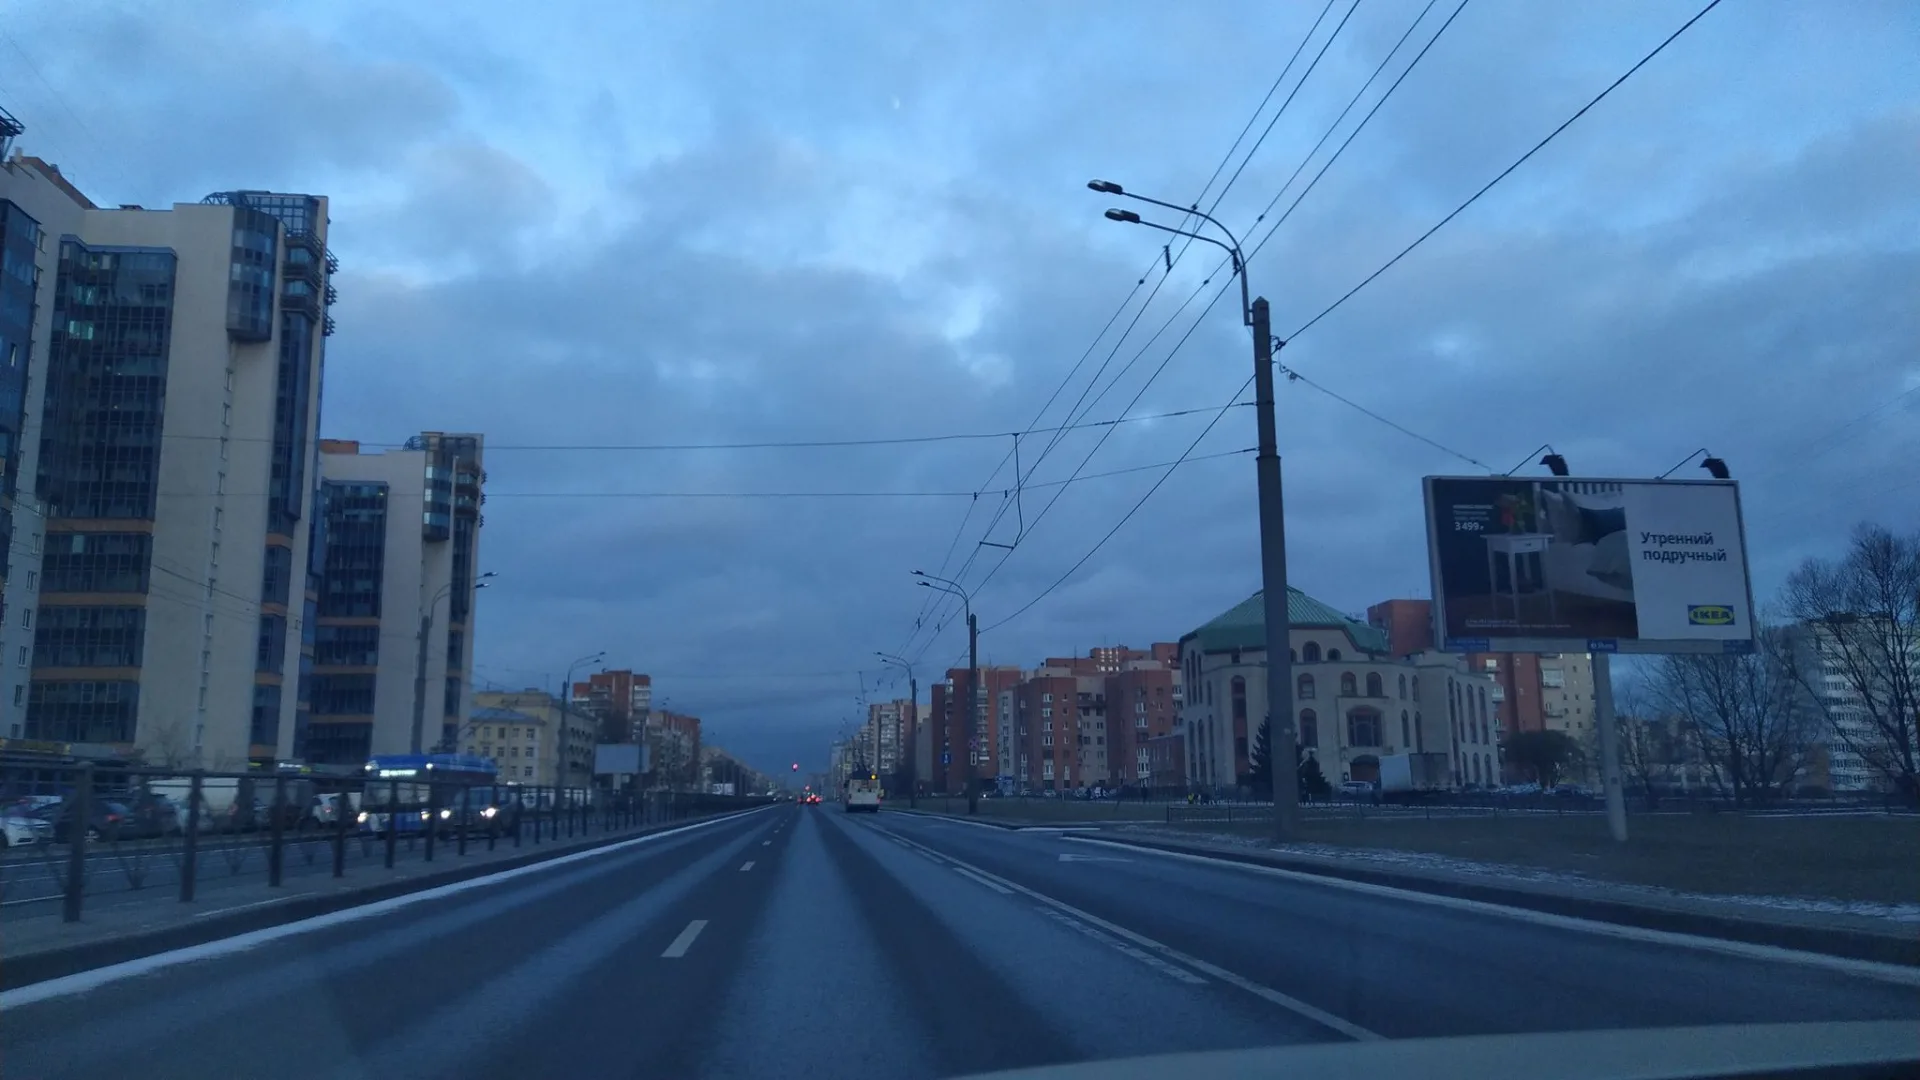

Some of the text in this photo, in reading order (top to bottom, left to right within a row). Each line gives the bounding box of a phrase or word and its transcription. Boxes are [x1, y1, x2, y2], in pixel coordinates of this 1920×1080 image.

[1641, 531, 1714, 547] Утренний
[1643, 548, 1727, 564] подручный
[1693, 610, 1730, 620] IKEA
